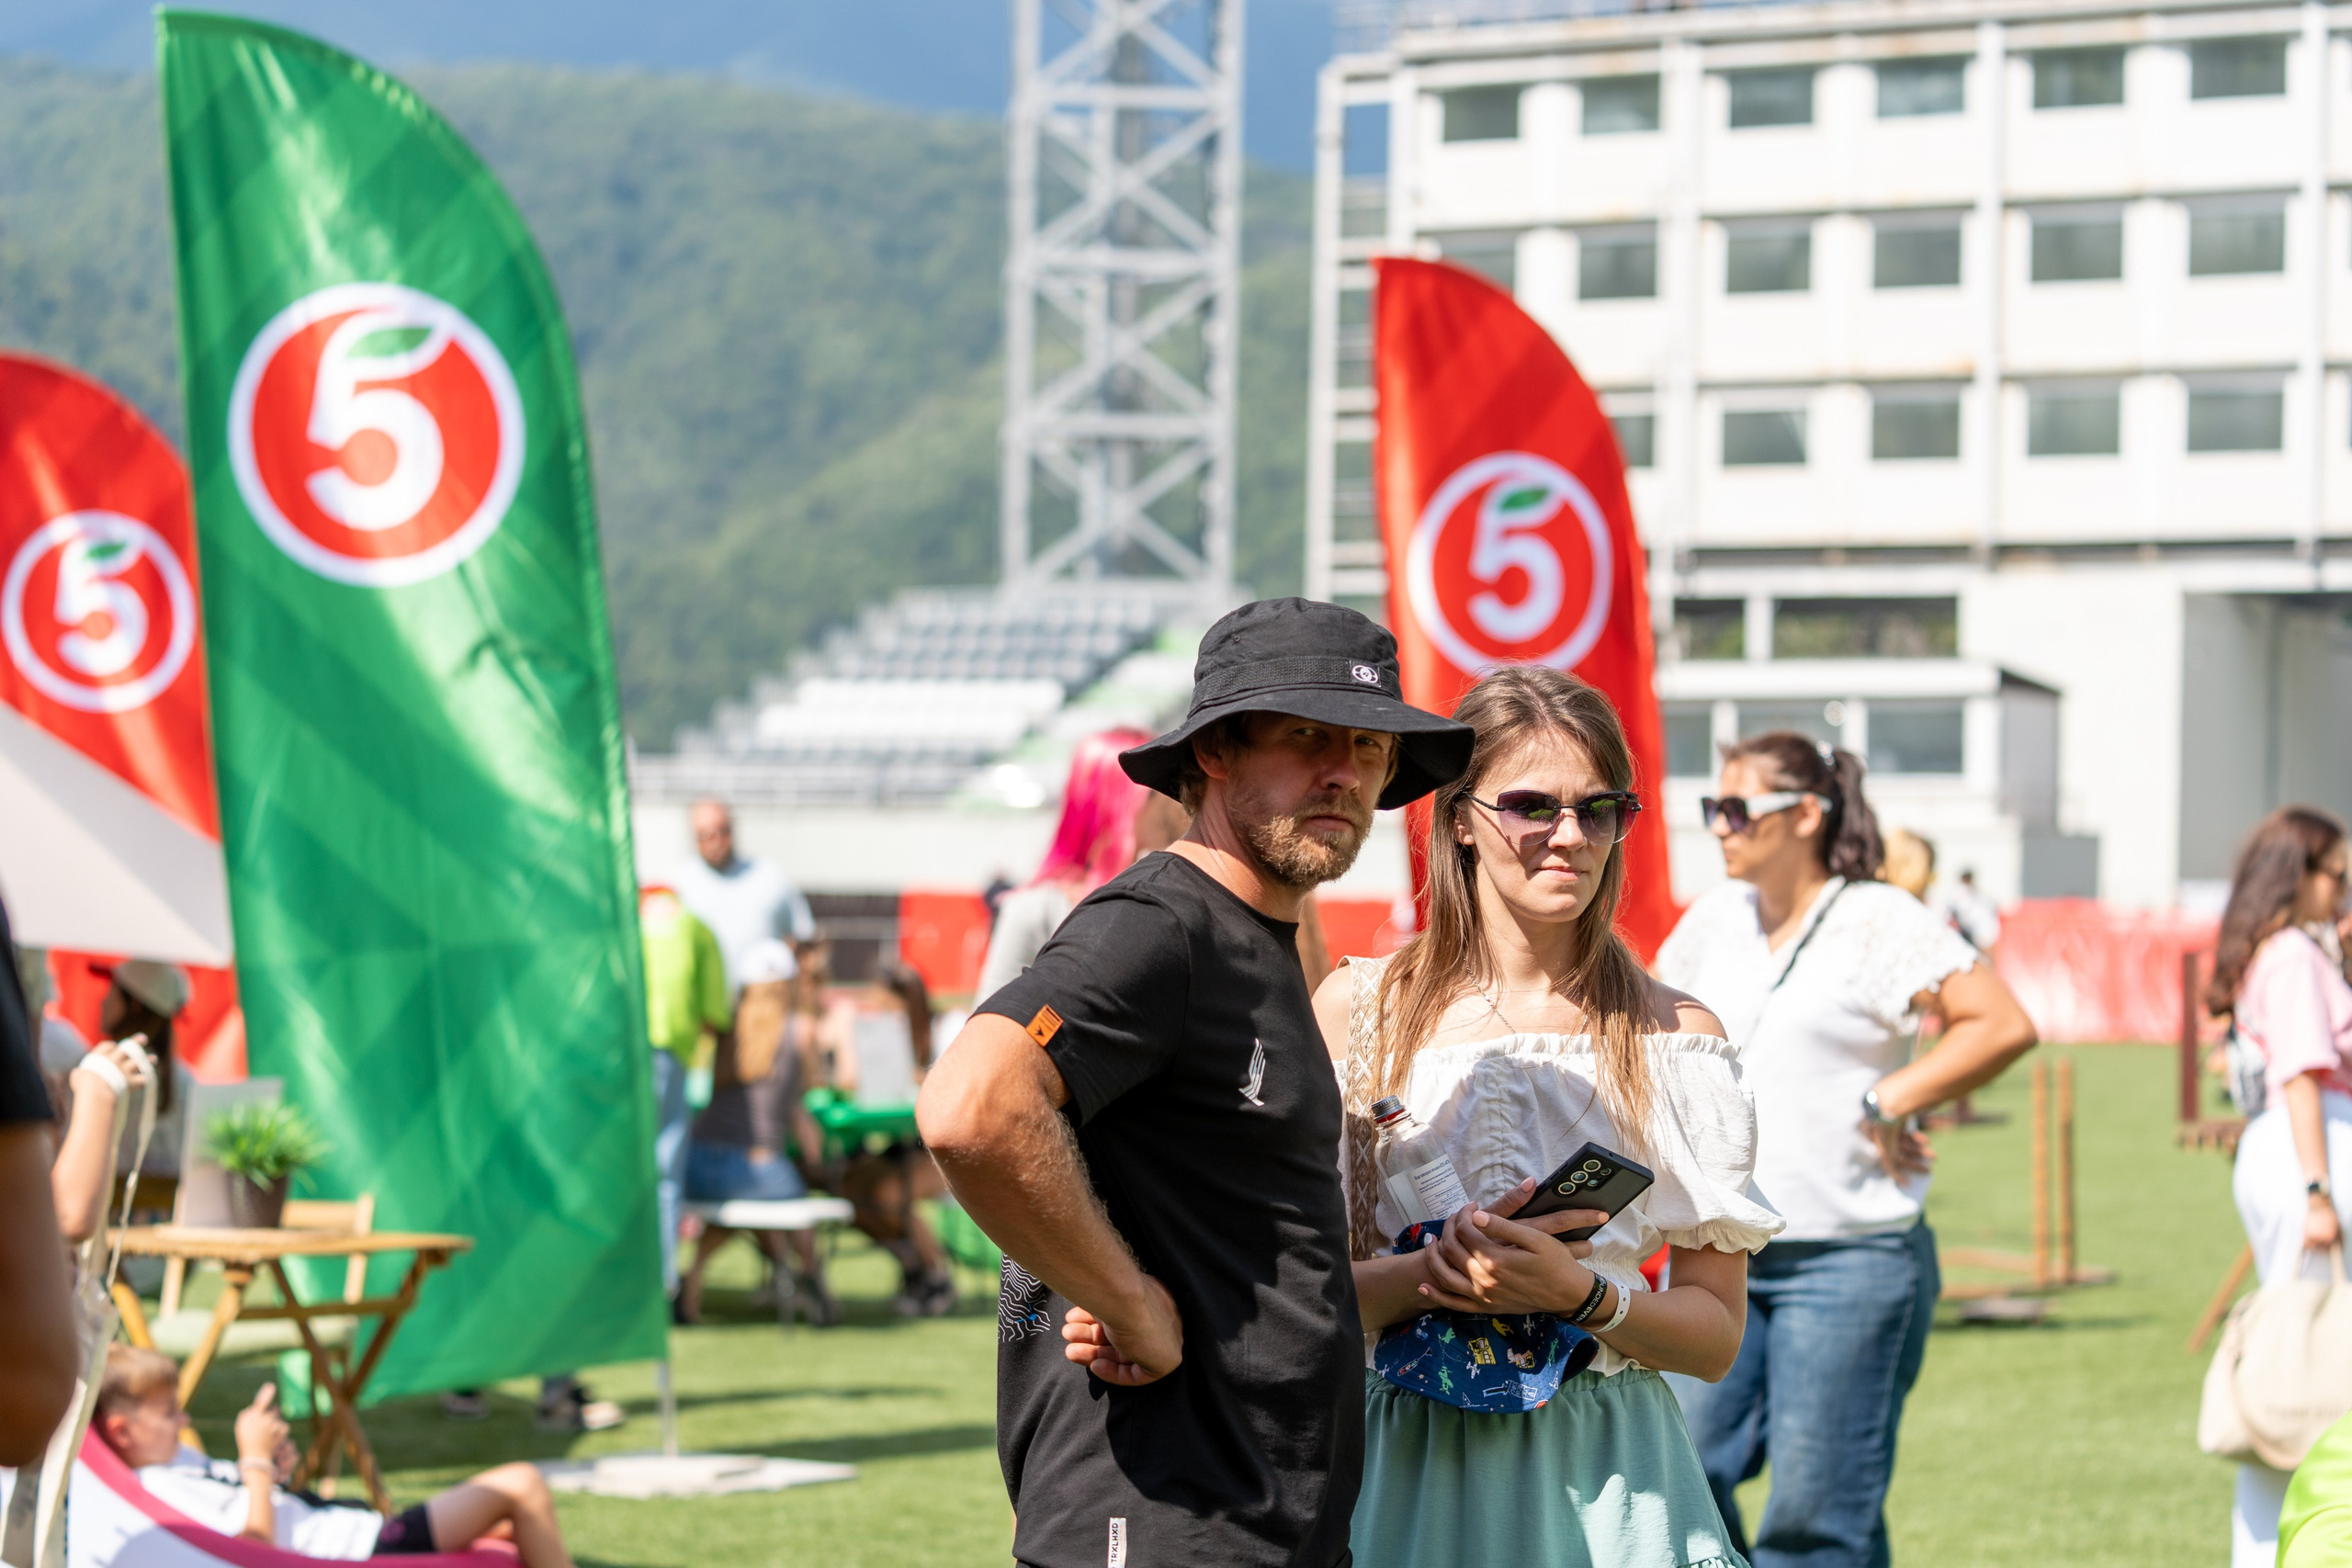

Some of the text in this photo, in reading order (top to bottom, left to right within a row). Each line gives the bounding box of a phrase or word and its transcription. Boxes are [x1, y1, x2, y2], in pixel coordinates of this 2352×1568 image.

[305, 307, 452, 532] 5
[53, 530, 149, 677] 5
[1467, 477, 1566, 644] 5
